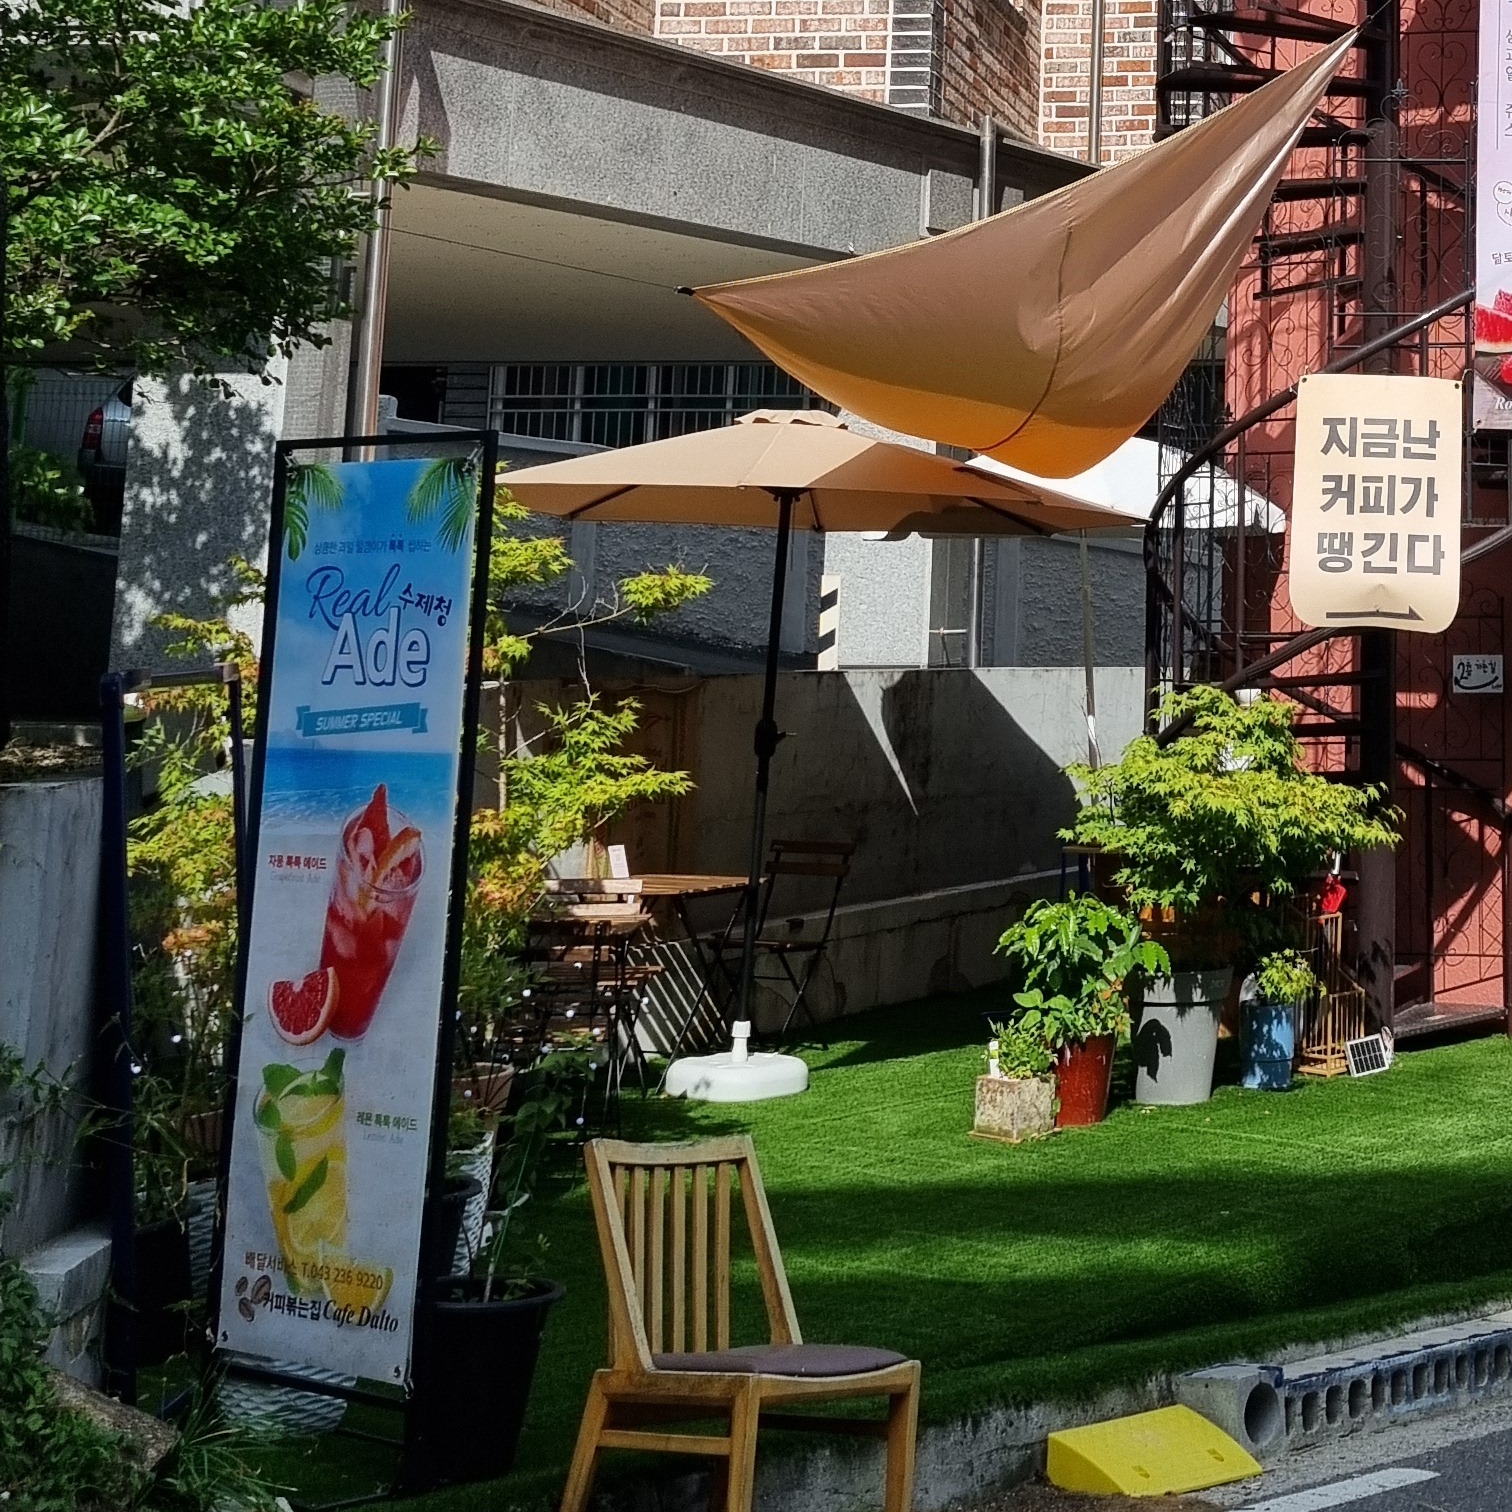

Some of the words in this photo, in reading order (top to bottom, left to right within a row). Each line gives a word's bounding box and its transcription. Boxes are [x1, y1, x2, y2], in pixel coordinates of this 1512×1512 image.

[1320, 417, 1441, 461] 지금난
[1319, 474, 1439, 518] 커피가
[1316, 531, 1445, 576] 땡긴다
[306, 563, 400, 631] Real
[398, 583, 452, 626] 수제청
[322, 606, 431, 688] Ade
[316, 714, 359, 732] SUMMER
[361, 711, 404, 728] SPECIAL
[303, 856, 327, 870] 에이드
[392, 1116, 418, 1131] 에이드
[245, 1251, 297, 1276] 배달서비스
[334, 1267, 352, 1284] 236
[356, 1272, 383, 1290] 9220
[263, 1291, 321, 1321] 커피볶는집
[323, 1299, 355, 1329] Cafe
[357, 1305, 399, 1333] Dalto
